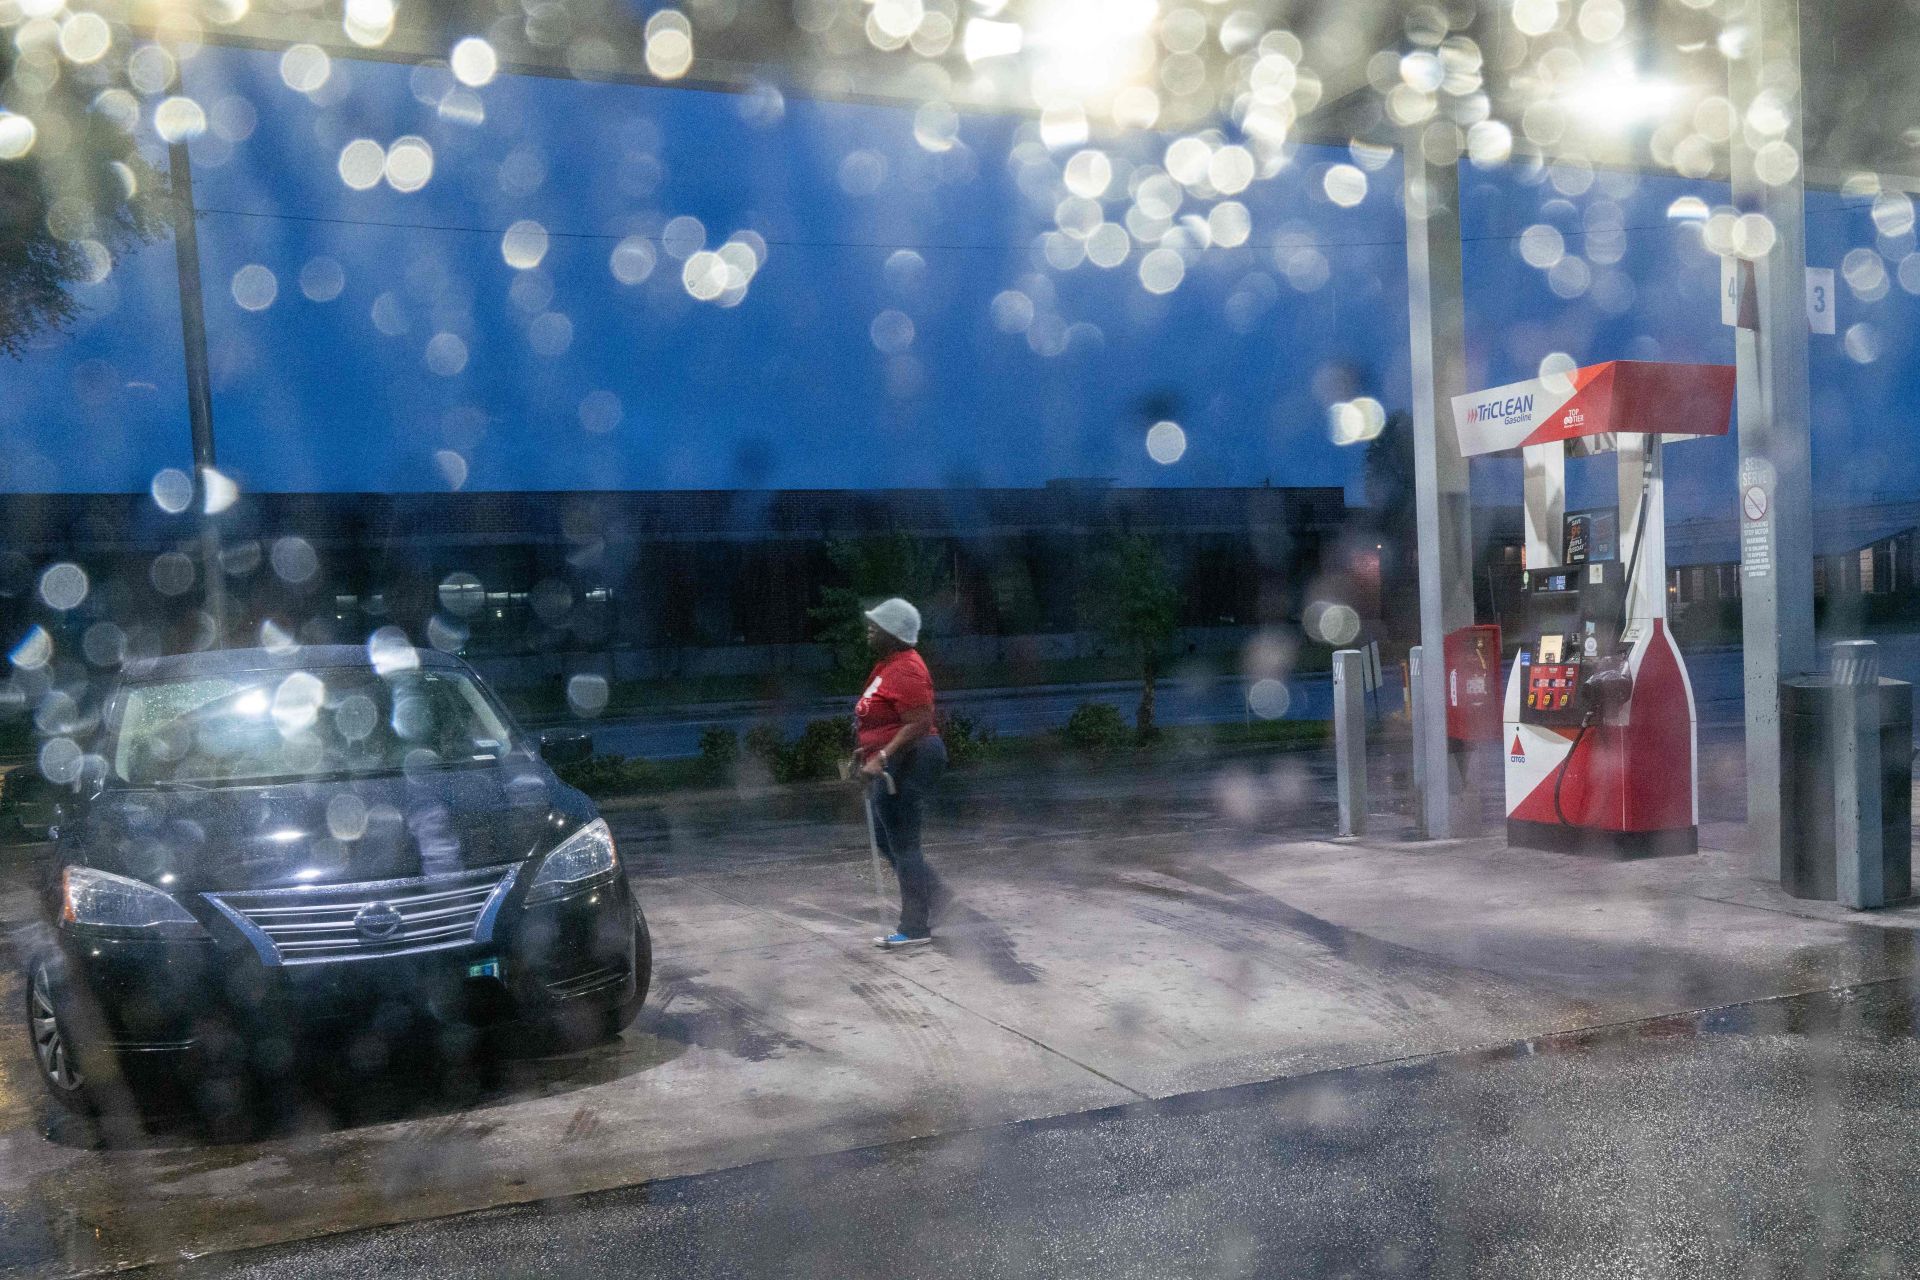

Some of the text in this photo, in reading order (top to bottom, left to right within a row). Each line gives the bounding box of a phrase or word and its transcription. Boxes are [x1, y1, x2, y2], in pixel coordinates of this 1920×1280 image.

[1728, 276, 1737, 305] 4
[1813, 285, 1826, 313] 3
[1477, 394, 1533, 421] TriCLEAN
[1569, 408, 1580, 417] TOP
[1504, 413, 1532, 425] Gasoline
[1573, 415, 1584, 423] TIER
[1510, 755, 1526, 763] CITGO
